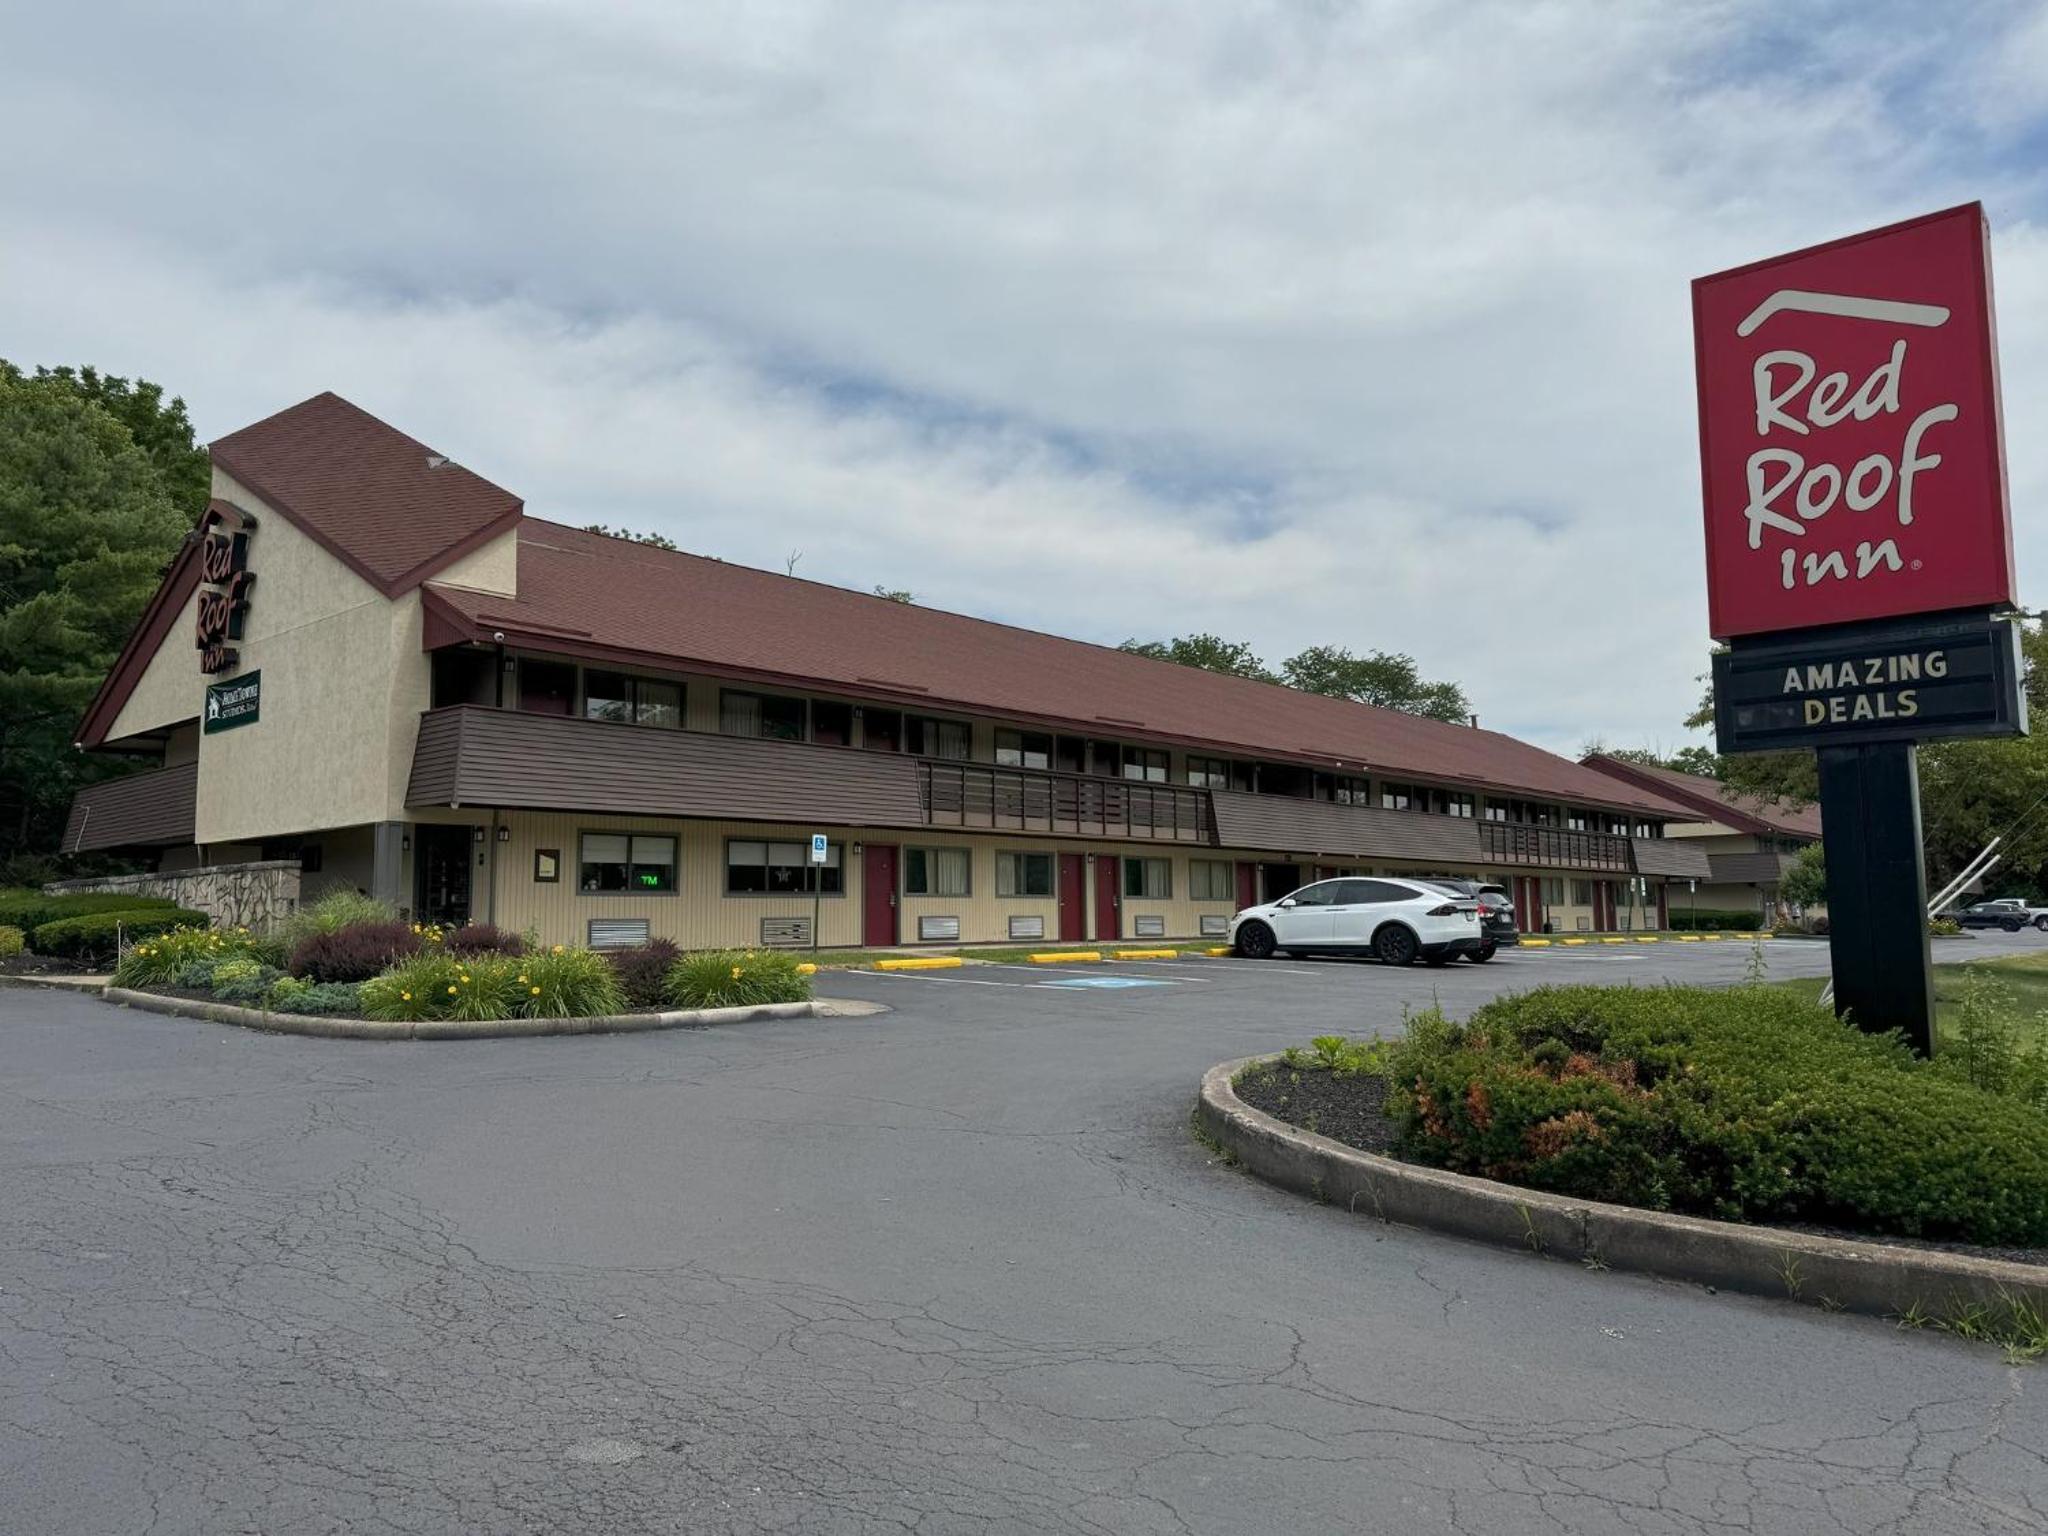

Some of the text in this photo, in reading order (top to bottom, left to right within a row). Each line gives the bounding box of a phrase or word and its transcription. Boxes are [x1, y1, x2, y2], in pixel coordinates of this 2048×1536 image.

[1753, 339, 1907, 436] Red
[1744, 403, 1959, 550] Roof
[202, 531, 244, 583] Red
[196, 570, 248, 646] Roof
[1782, 650, 1949, 694] AMAZING
[1804, 690, 1919, 726] DEALS
